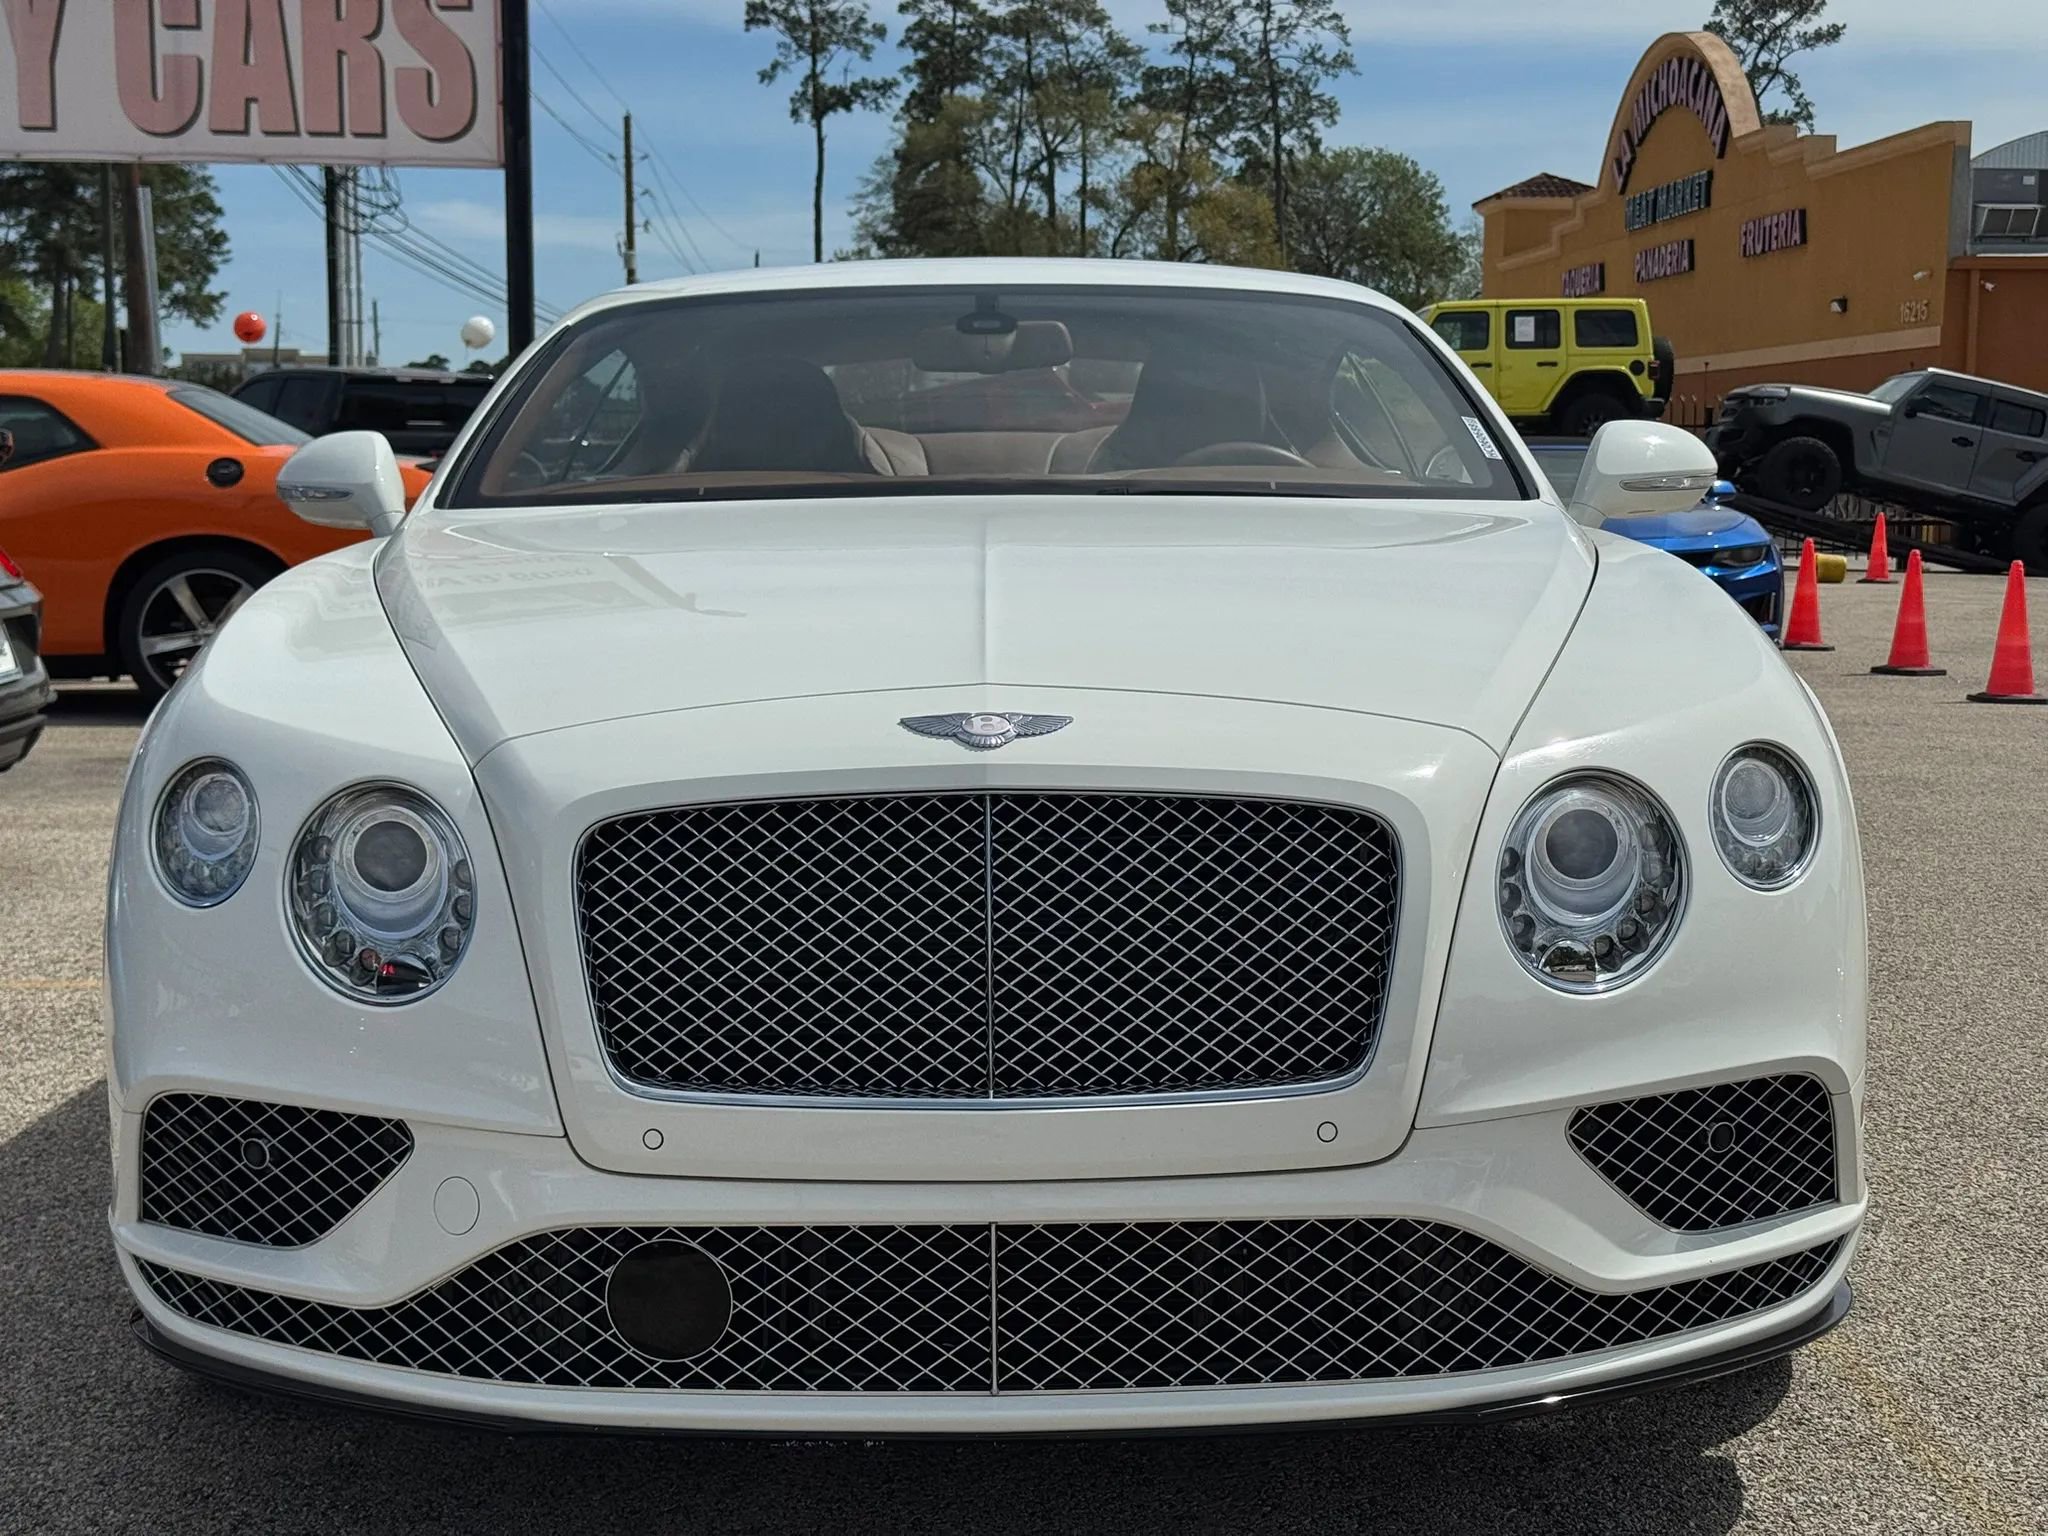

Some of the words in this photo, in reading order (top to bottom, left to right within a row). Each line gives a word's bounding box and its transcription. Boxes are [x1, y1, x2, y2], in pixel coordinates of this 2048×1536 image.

[114, 0, 477, 141] CARS
[1612, 130, 1634, 195] LA
[1632, 57, 1728, 158] MICHOACANA
[1625, 192, 1655, 231] MEAT
[1656, 170, 1709, 222] MARKET
[1740, 209, 1803, 257] FRUTERIA
[1562, 263, 1601, 297] TAQUERIA
[1634, 240, 1691, 283] PANADERIA
[1900, 299, 1928, 323] 16215
